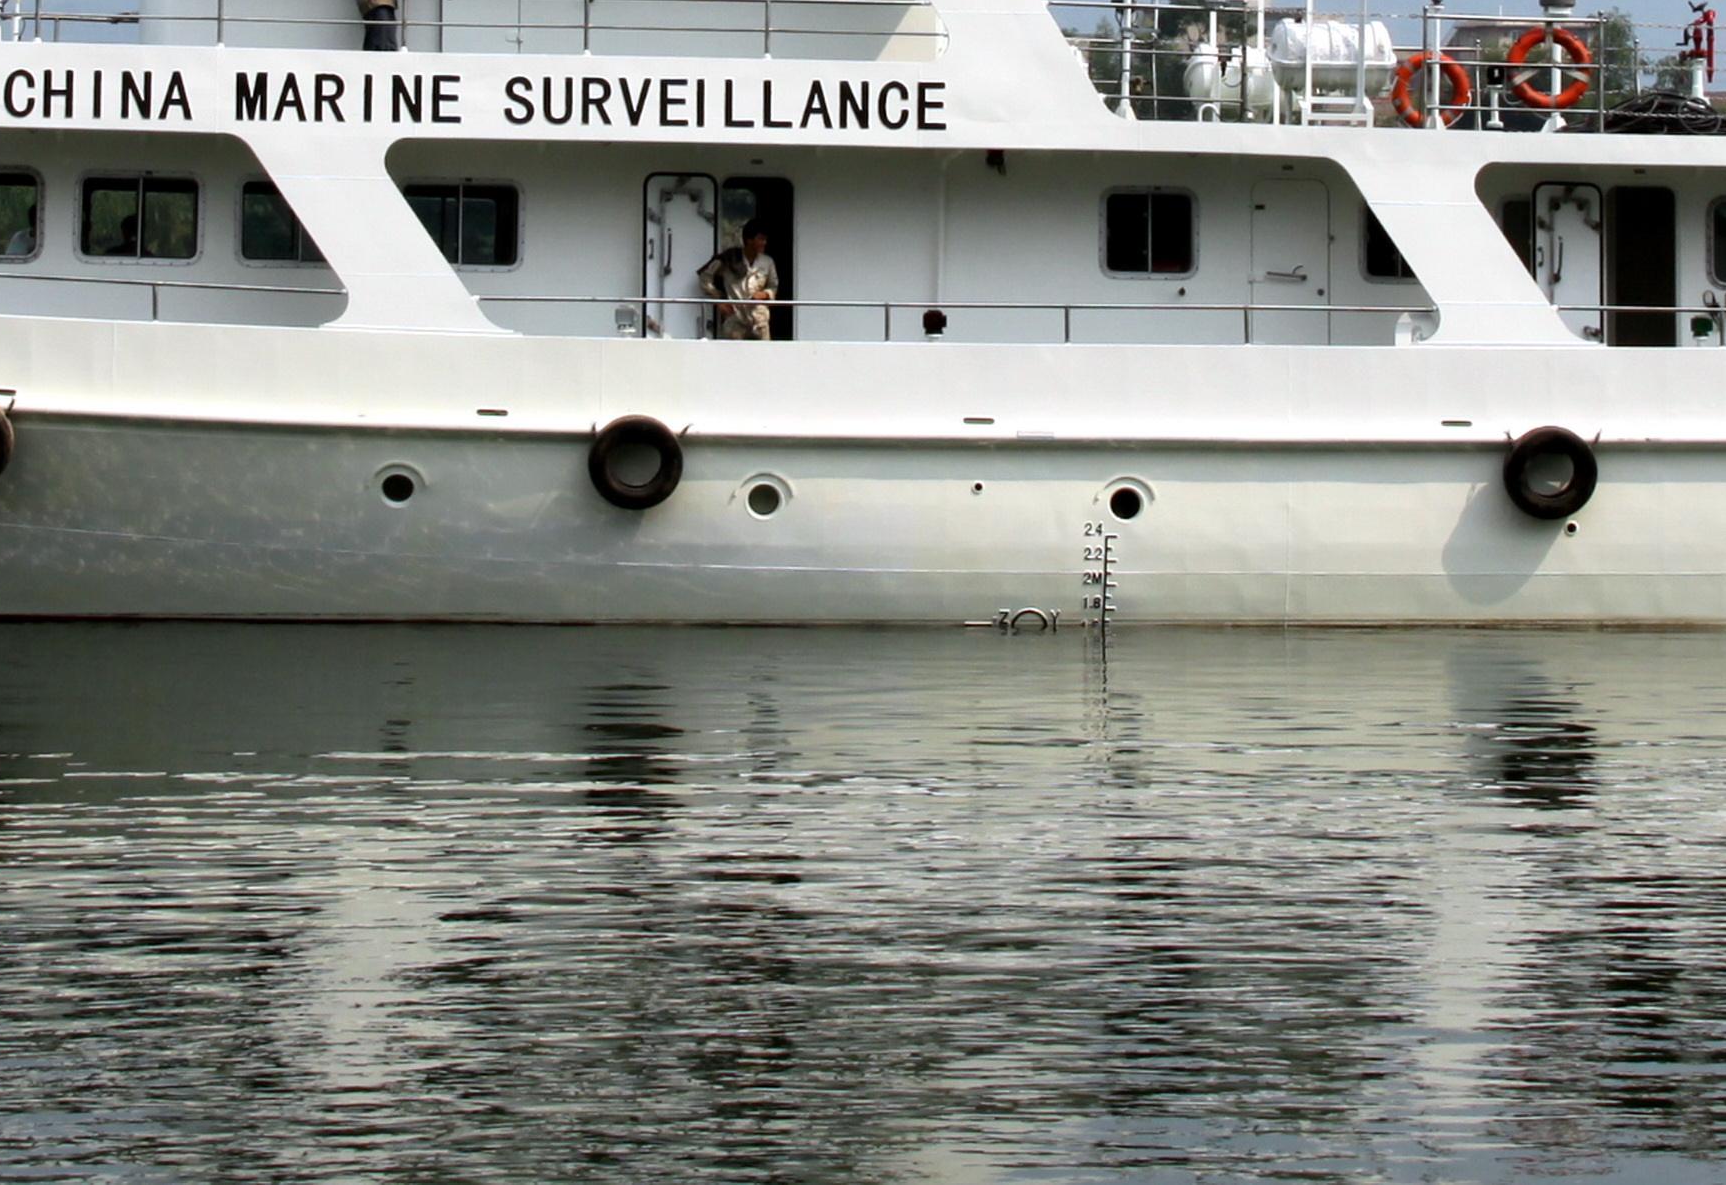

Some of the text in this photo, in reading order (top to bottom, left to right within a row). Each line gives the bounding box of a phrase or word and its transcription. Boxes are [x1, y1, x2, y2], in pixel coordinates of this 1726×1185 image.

[2, 68, 948, 132] CHINA MARINE SURVEILLANCE
[1083, 572, 1102, 586] 2M
